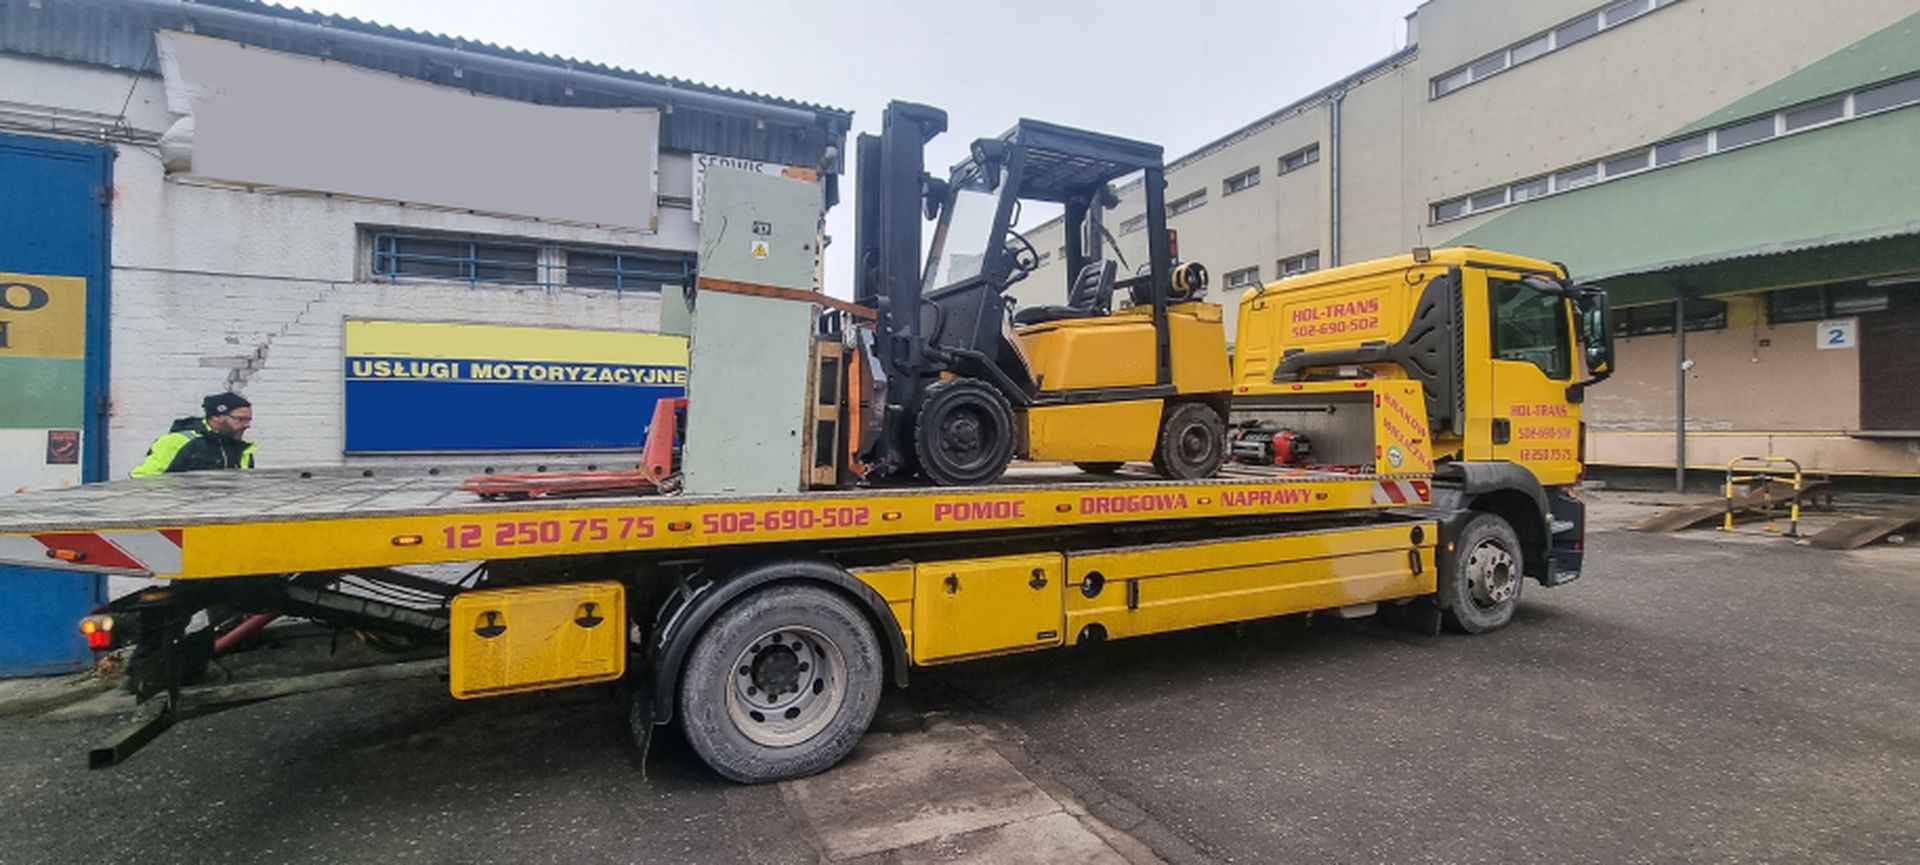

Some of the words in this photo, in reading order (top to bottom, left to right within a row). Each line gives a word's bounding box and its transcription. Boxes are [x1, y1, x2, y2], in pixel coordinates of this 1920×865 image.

[1292, 298, 1378, 323] HOL-TRANS
[1292, 317, 1378, 338] 502-690-502
[1828, 329, 1845, 345] 2
[352, 360, 458, 379] USŁUGI
[470, 362, 687, 384] MOTORYZACYJNE
[1511, 404, 1567, 417] HOL-TRANS
[443, 524, 481, 549] 12
[495, 520, 560, 547] 250
[570, 518, 608, 541] 75
[618, 516, 655, 538] 75
[703, 507, 869, 533] 502-690-502
[934, 501, 1025, 521] POMOC
[1080, 493, 1188, 514] DROGOWA
[1220, 488, 1312, 507] NAPRAWY
